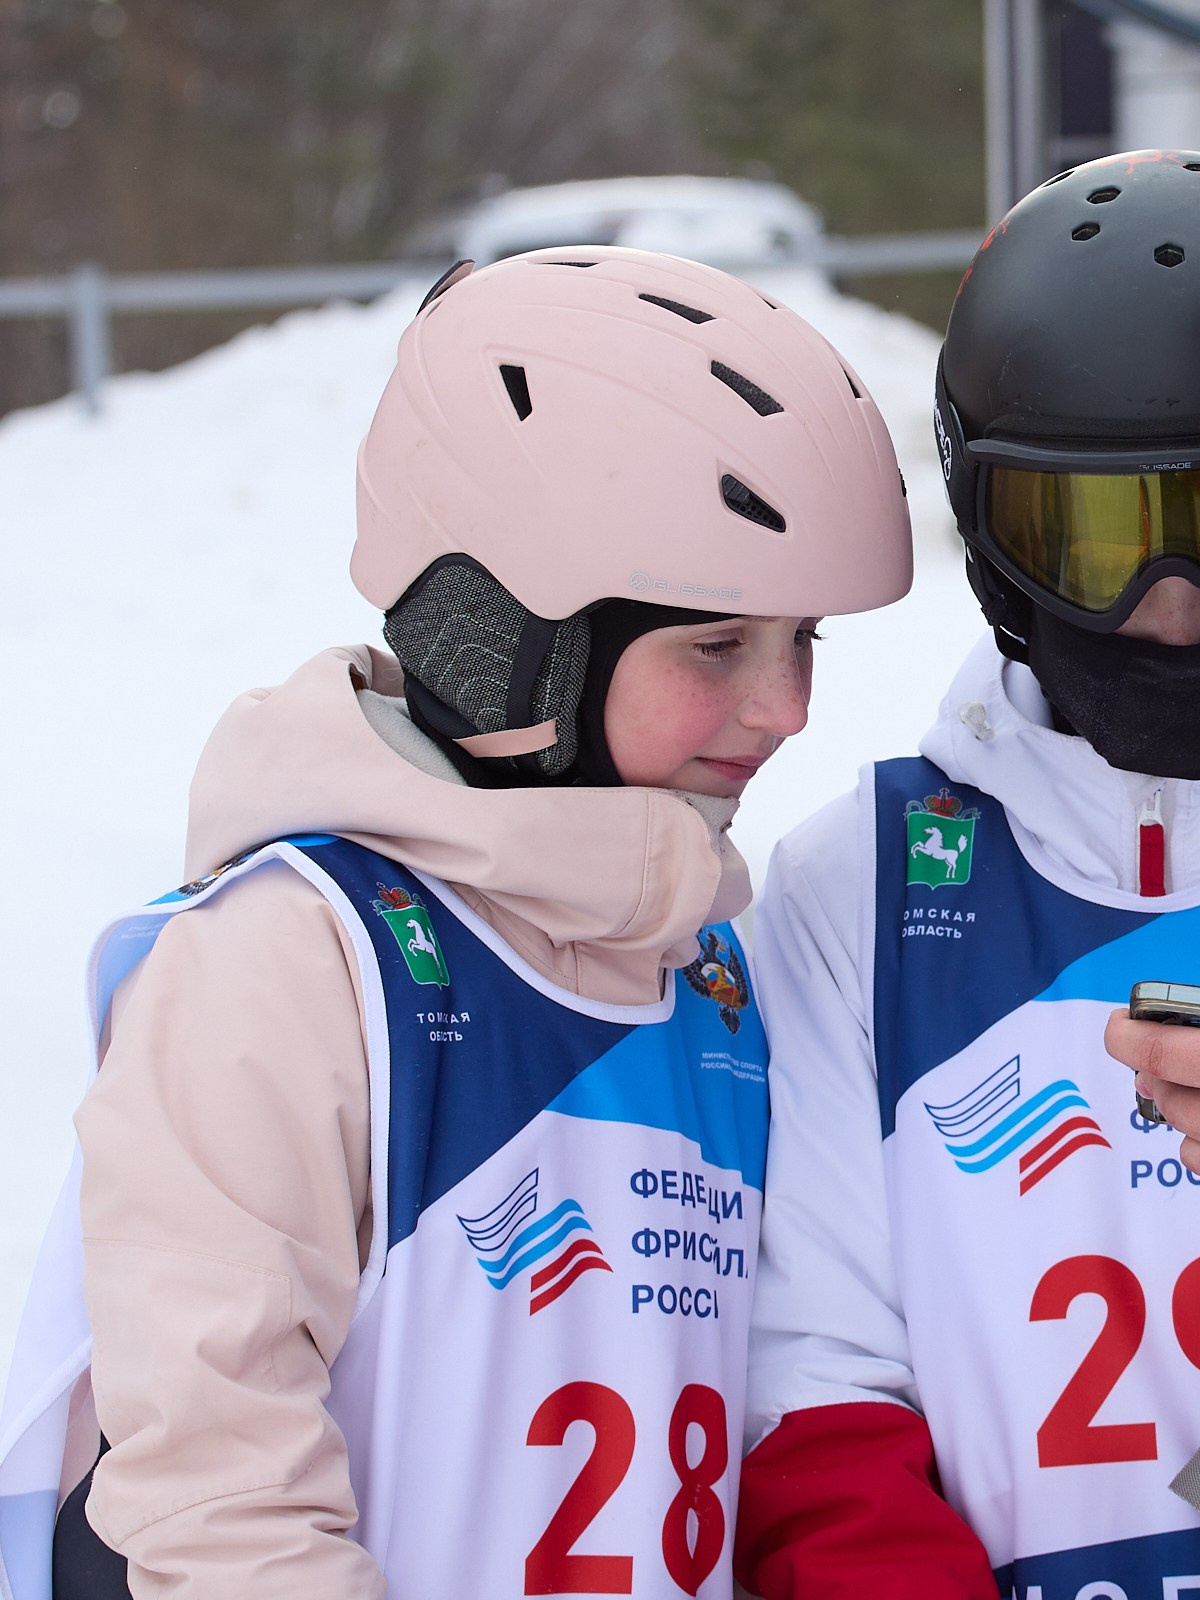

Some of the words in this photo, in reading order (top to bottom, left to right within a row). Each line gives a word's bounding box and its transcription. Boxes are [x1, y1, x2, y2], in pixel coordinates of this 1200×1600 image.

[652, 580, 743, 600] GLISSADE
[903, 908, 976, 922] ОМСКАЯ
[630, 1168, 744, 1224] ФЕДЕЦИ
[632, 1284, 719, 1319] РОСС
[524, 1380, 729, 1597] 28
